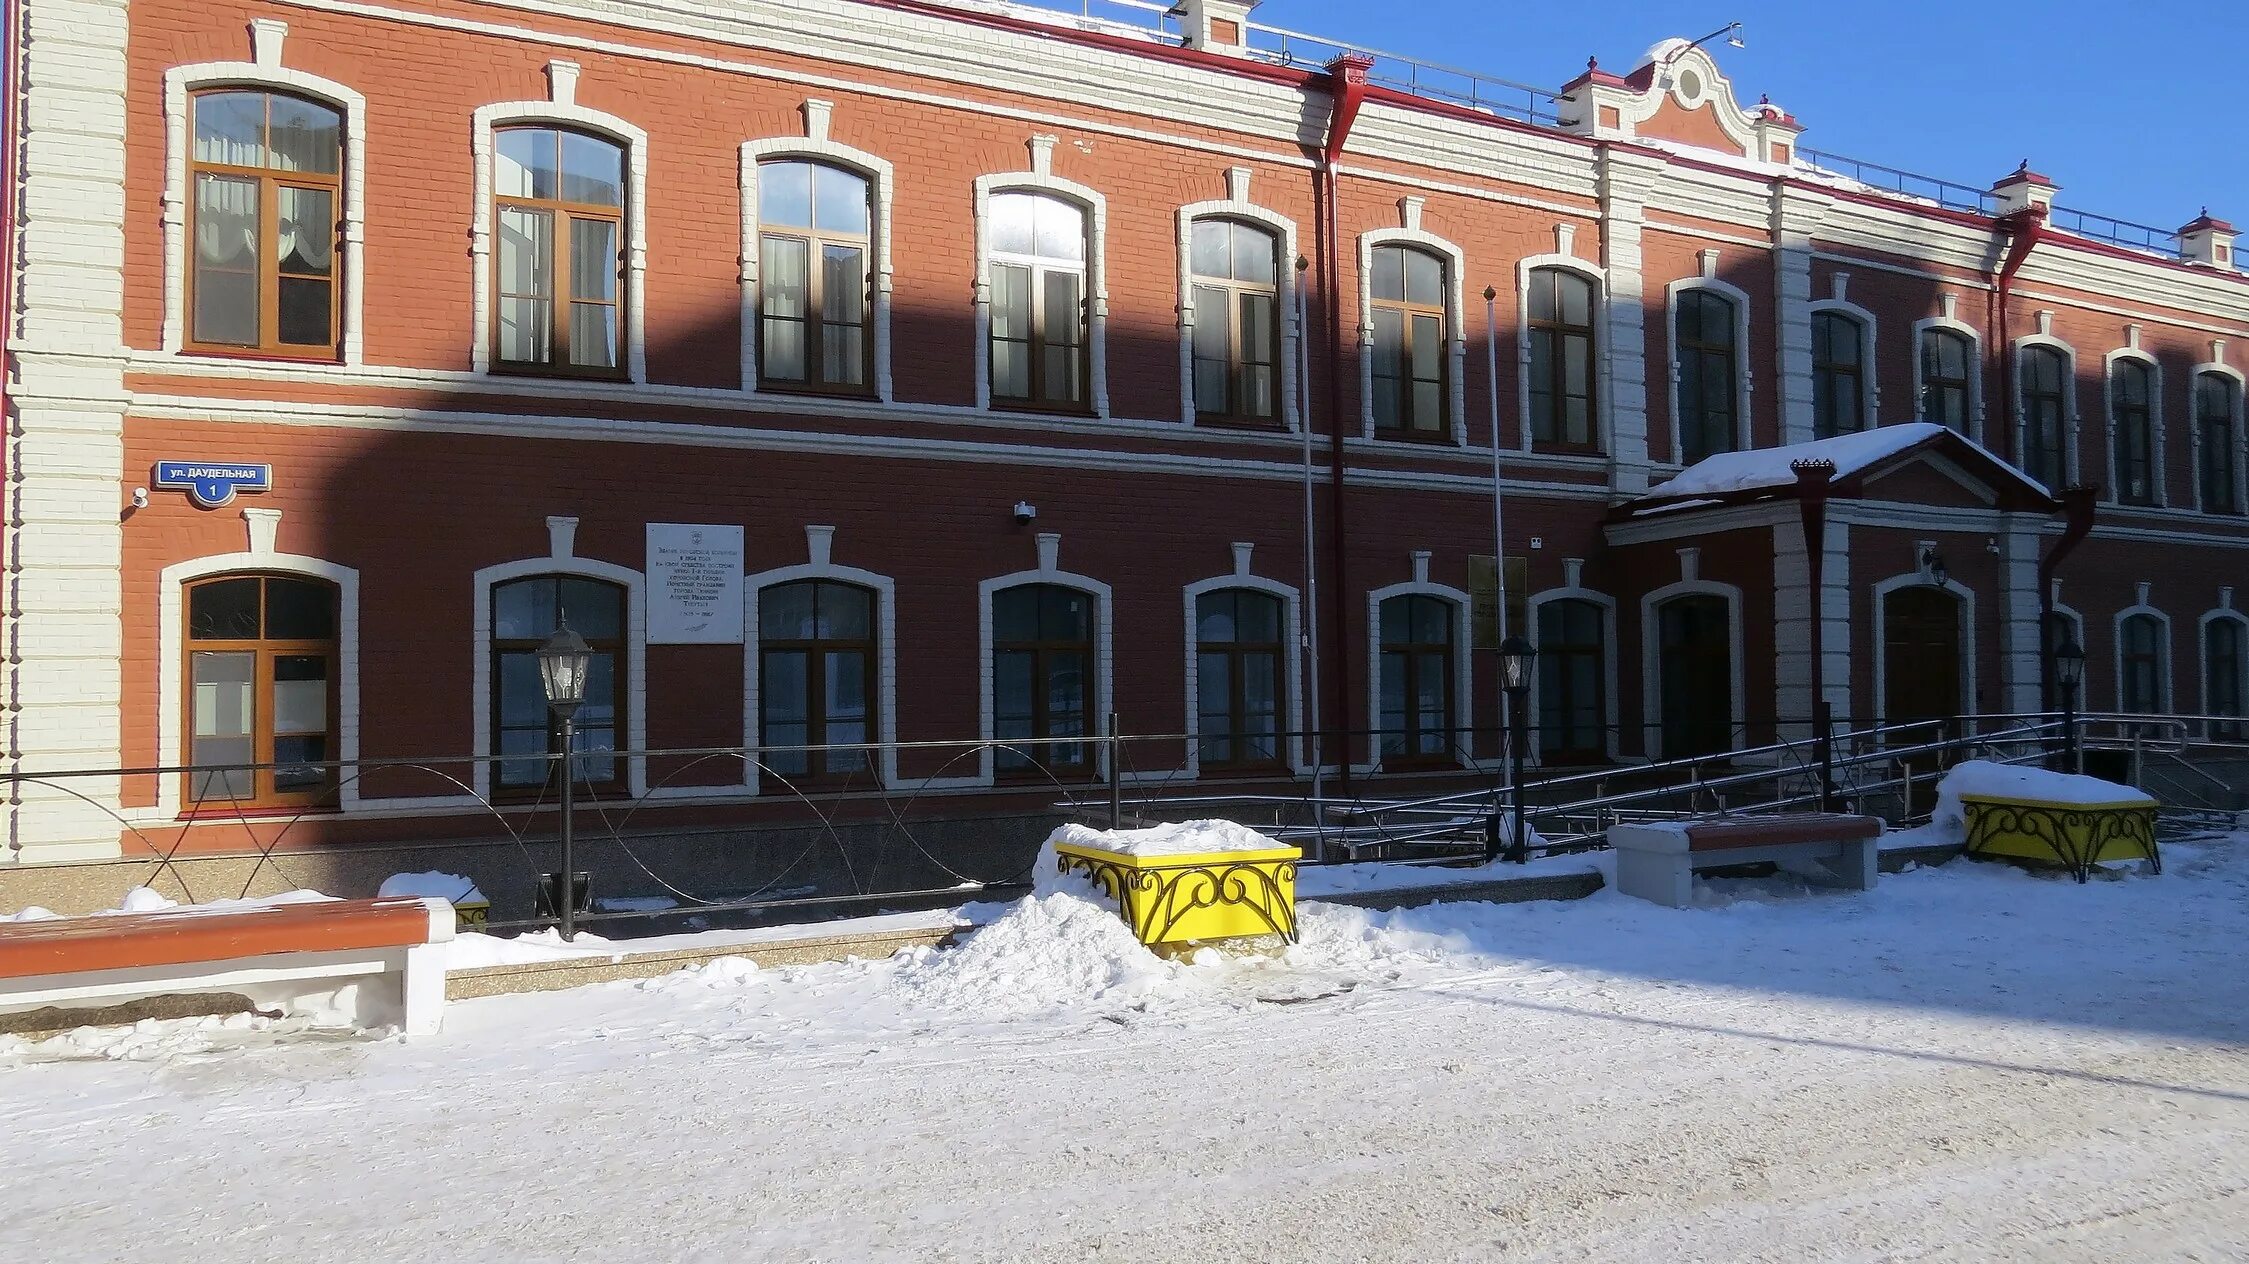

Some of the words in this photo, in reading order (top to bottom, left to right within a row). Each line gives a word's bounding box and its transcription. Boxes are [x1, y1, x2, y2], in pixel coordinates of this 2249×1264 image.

[170, 468, 186, 478] ул.
[188, 468, 256, 479] ДАУДЕЛЬНАЯ
[209, 484, 217, 496] 1
